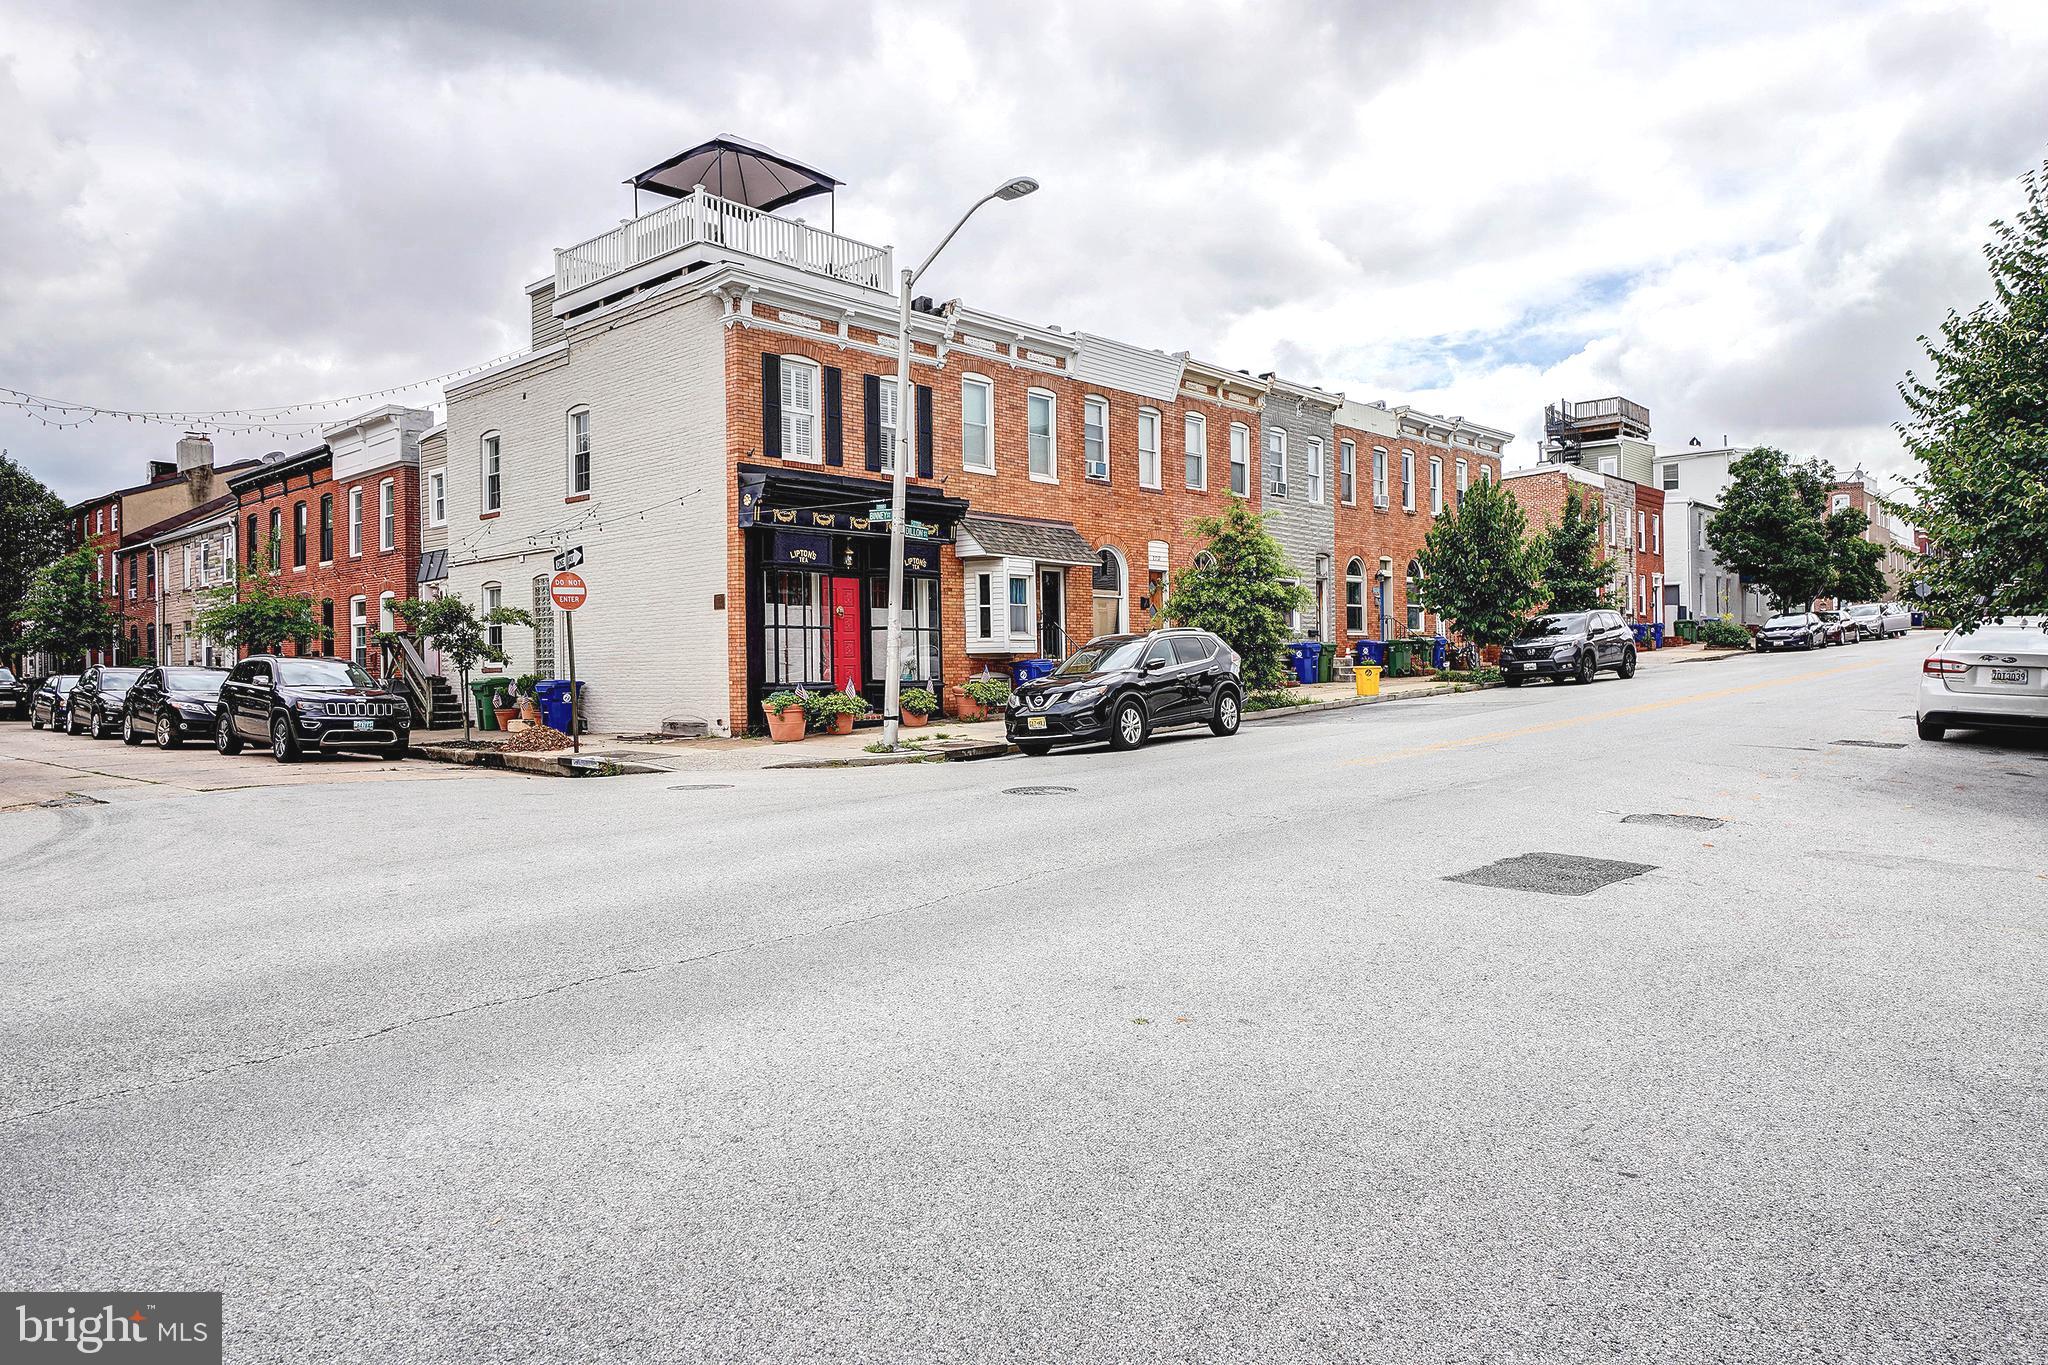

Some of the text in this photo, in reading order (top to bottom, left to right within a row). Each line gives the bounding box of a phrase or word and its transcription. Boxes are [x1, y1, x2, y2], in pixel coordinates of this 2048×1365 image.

[906, 527, 923, 537] DILLON
[790, 550, 817, 561] LIPTON'S
[557, 559, 565, 568] ONE
[904, 557, 927, 568] LIPTON'S
